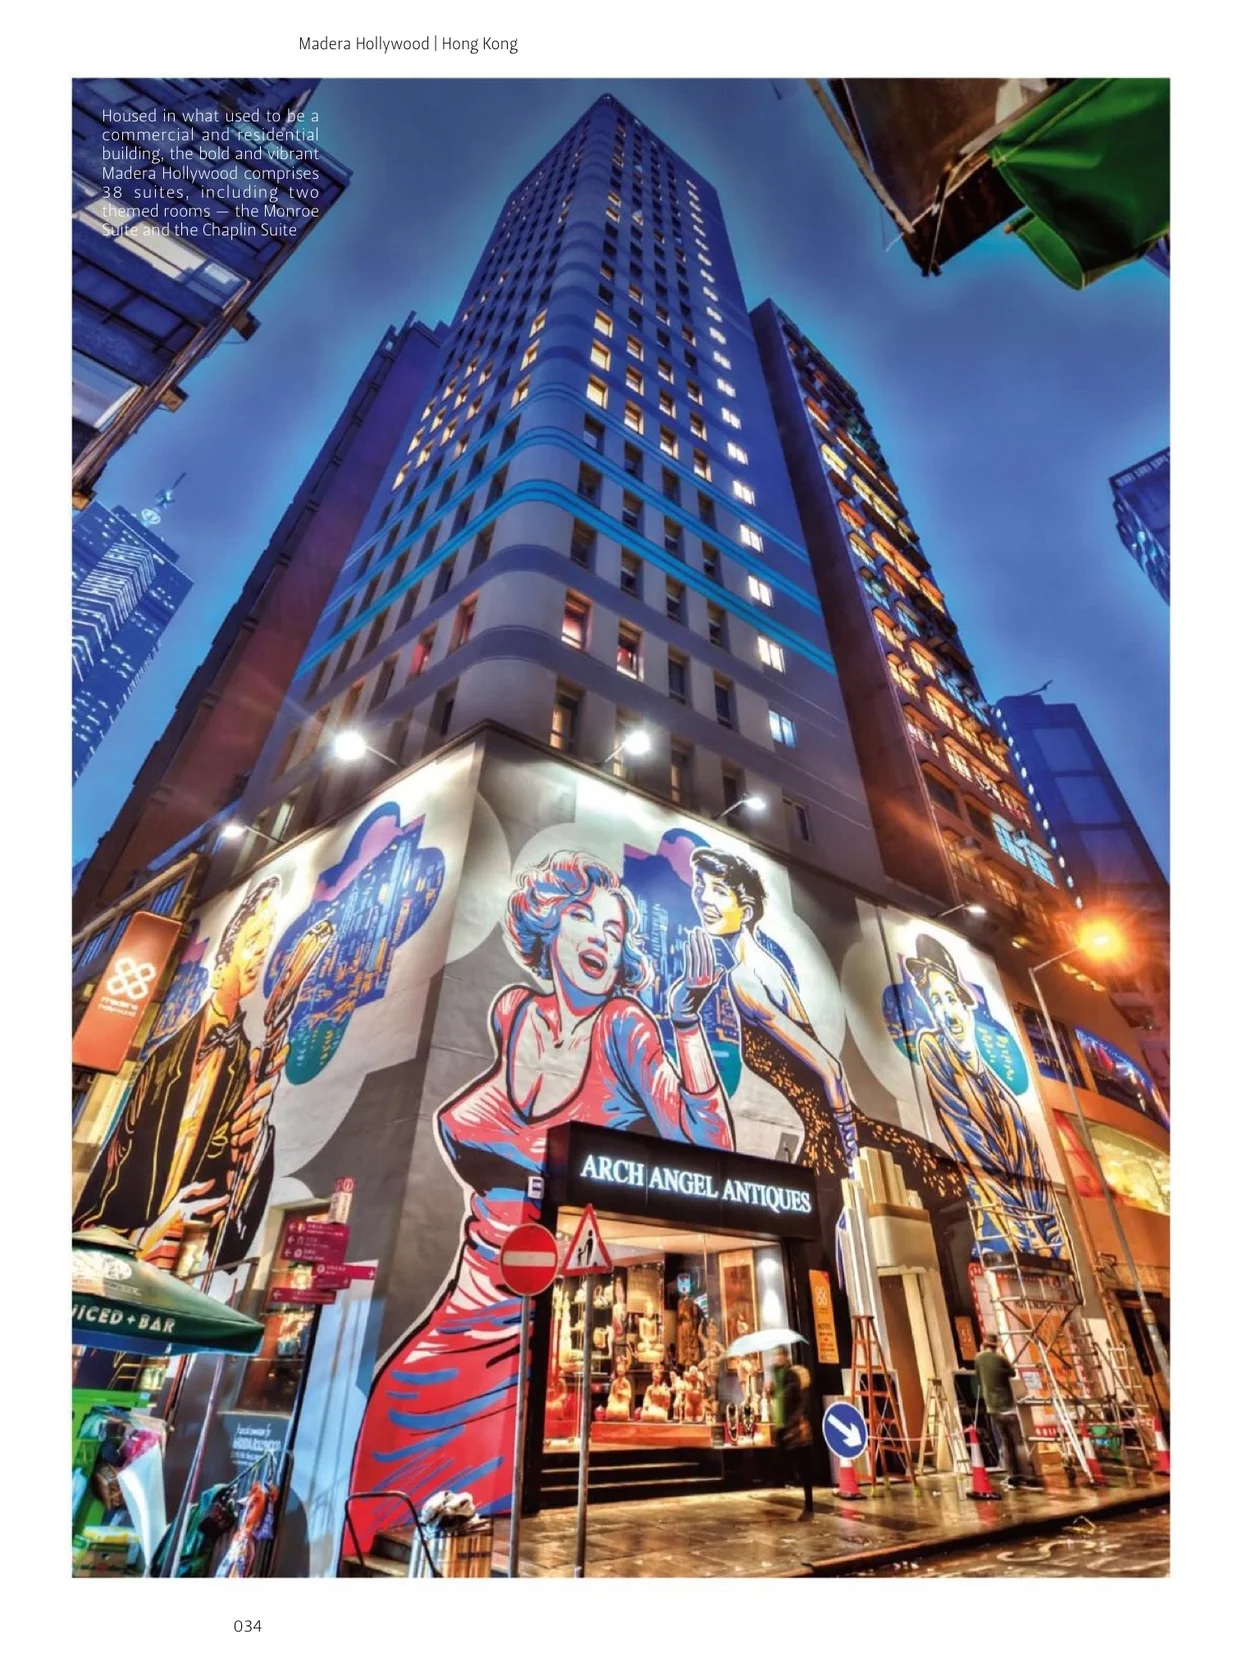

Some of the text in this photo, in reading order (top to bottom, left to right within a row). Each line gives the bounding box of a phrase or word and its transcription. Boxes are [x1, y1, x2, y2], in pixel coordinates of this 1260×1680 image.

[580, 1154, 812, 1214] ARCH ANGEL ANTIQUES
[138, 1313, 176, 1334] BAR
